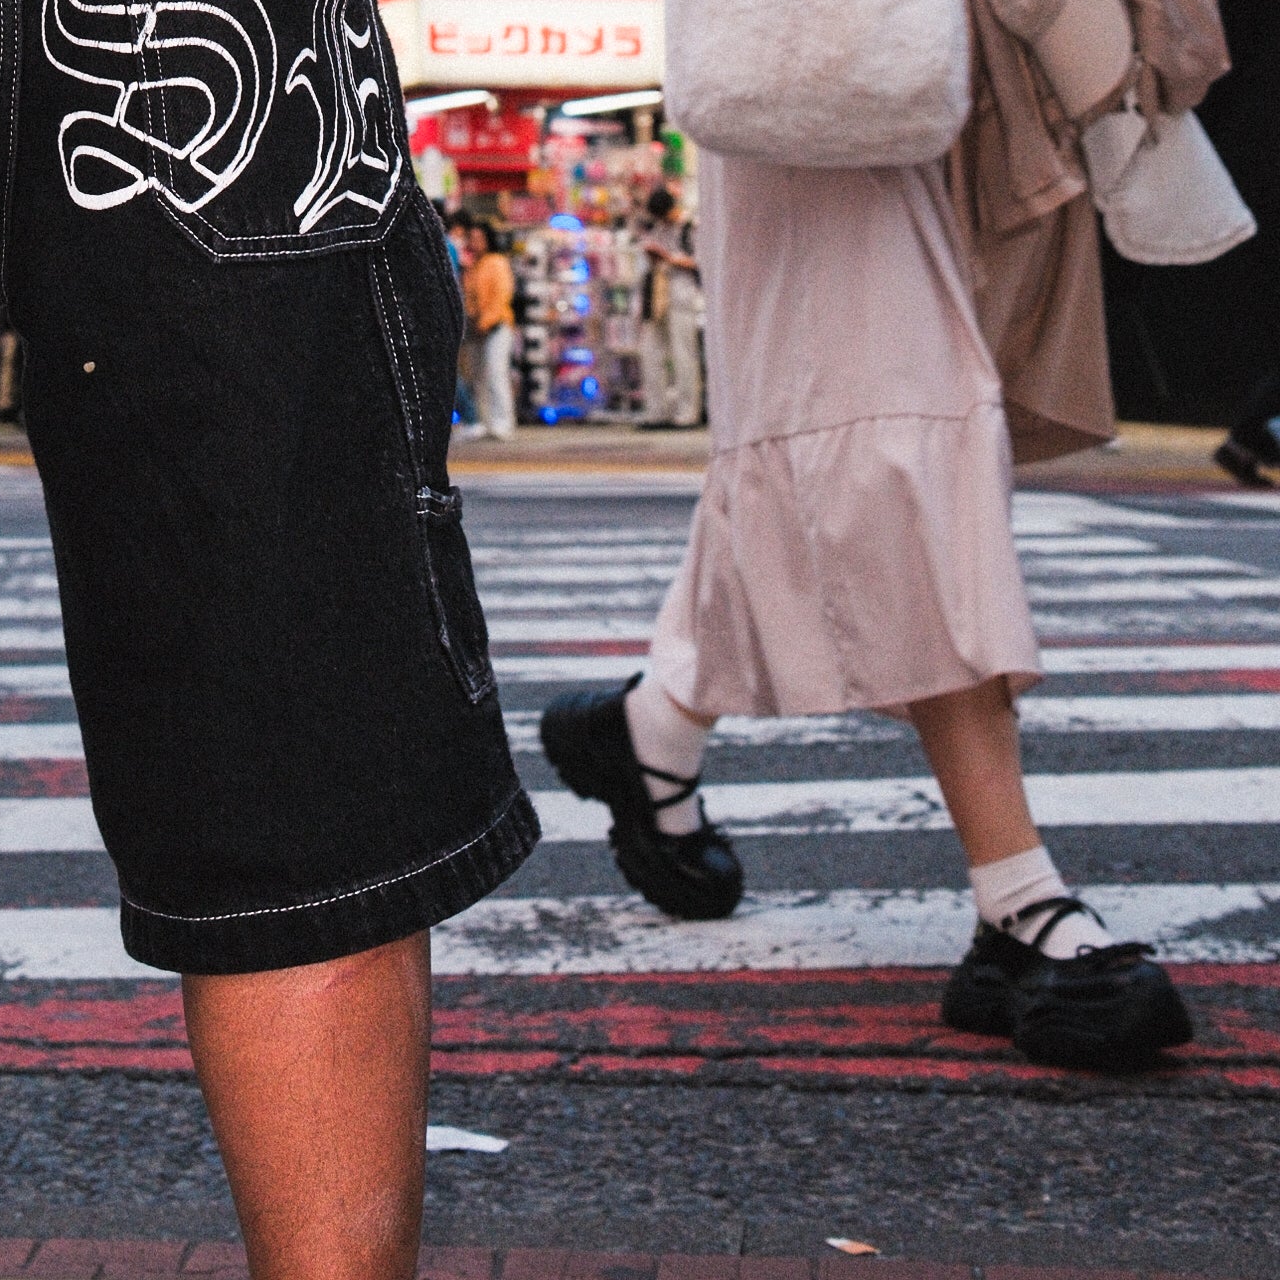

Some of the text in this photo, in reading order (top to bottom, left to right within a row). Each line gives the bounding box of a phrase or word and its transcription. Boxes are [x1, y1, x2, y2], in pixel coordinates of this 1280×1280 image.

[428, 20, 643, 59] ビックカメラ
